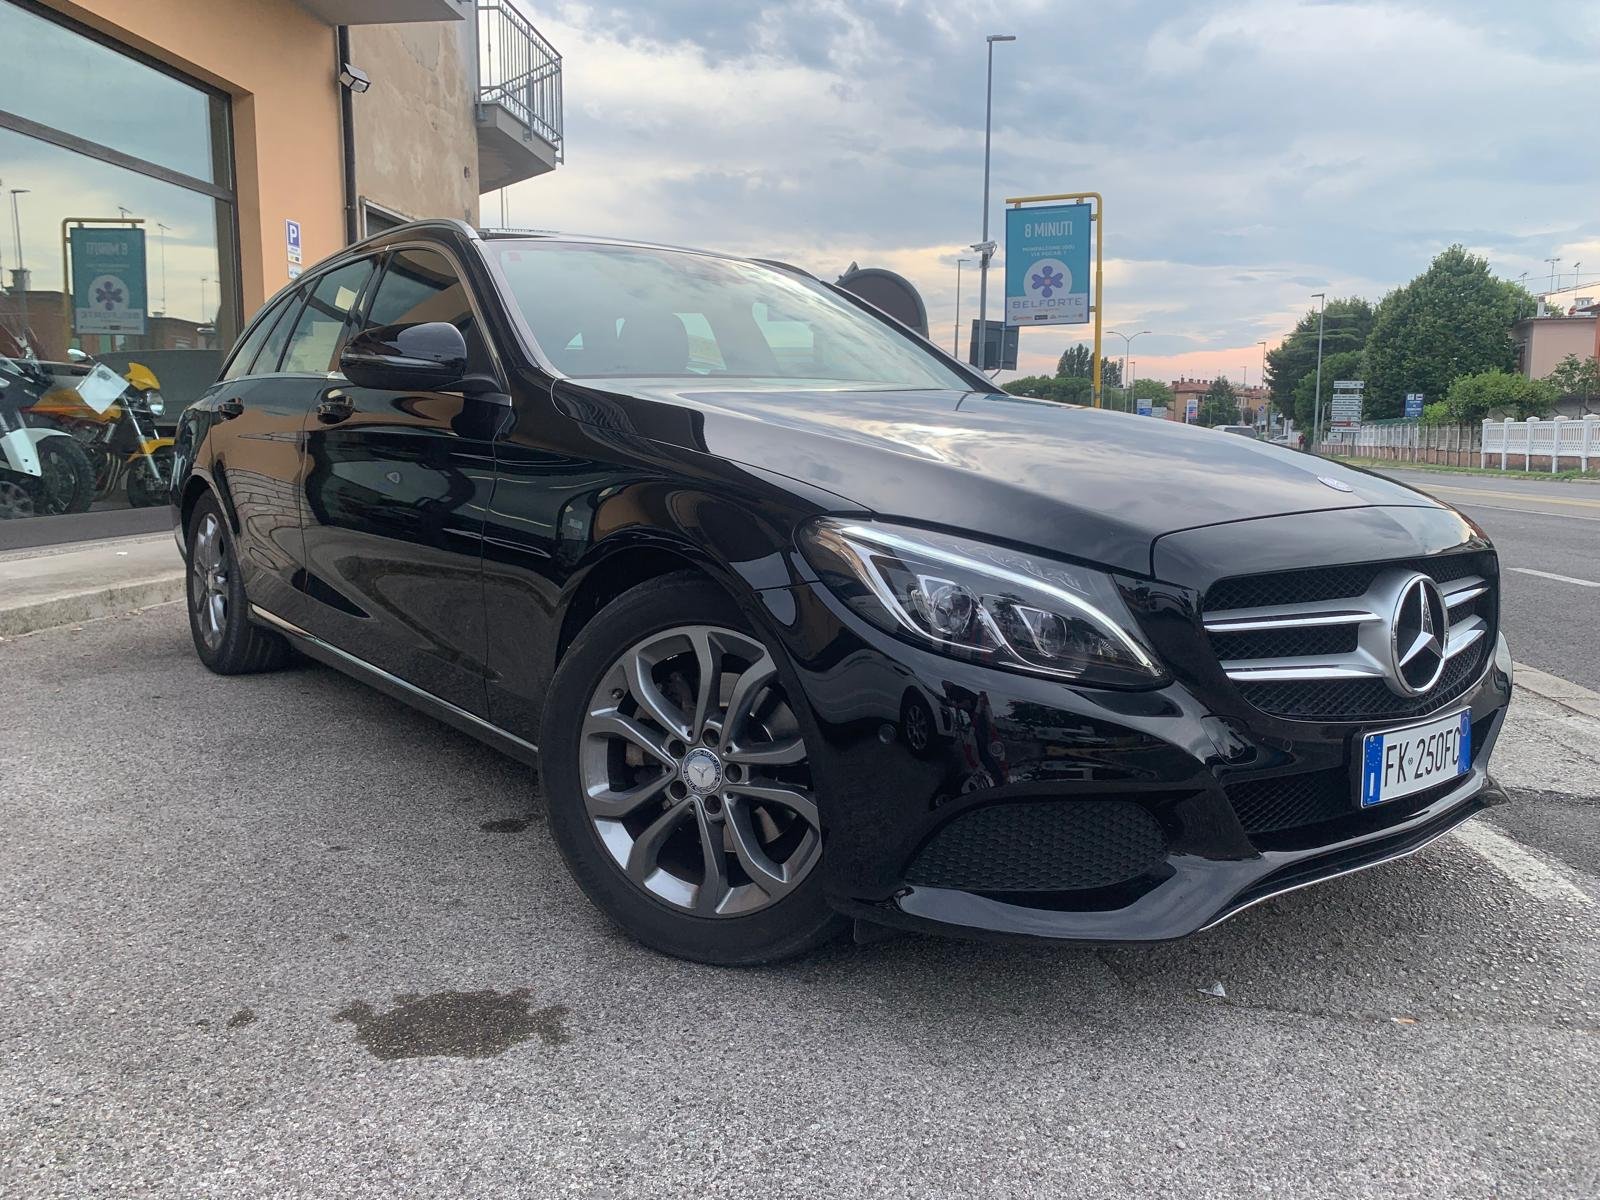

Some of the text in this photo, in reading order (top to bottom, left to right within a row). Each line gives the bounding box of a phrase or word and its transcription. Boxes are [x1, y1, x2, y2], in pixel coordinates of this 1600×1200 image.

[289, 224, 298, 244] P
[1024, 221, 1072, 238] 8 MINUTI
[1012, 297, 1083, 309] BELFORTE
[1384, 741, 1410, 787] FK
